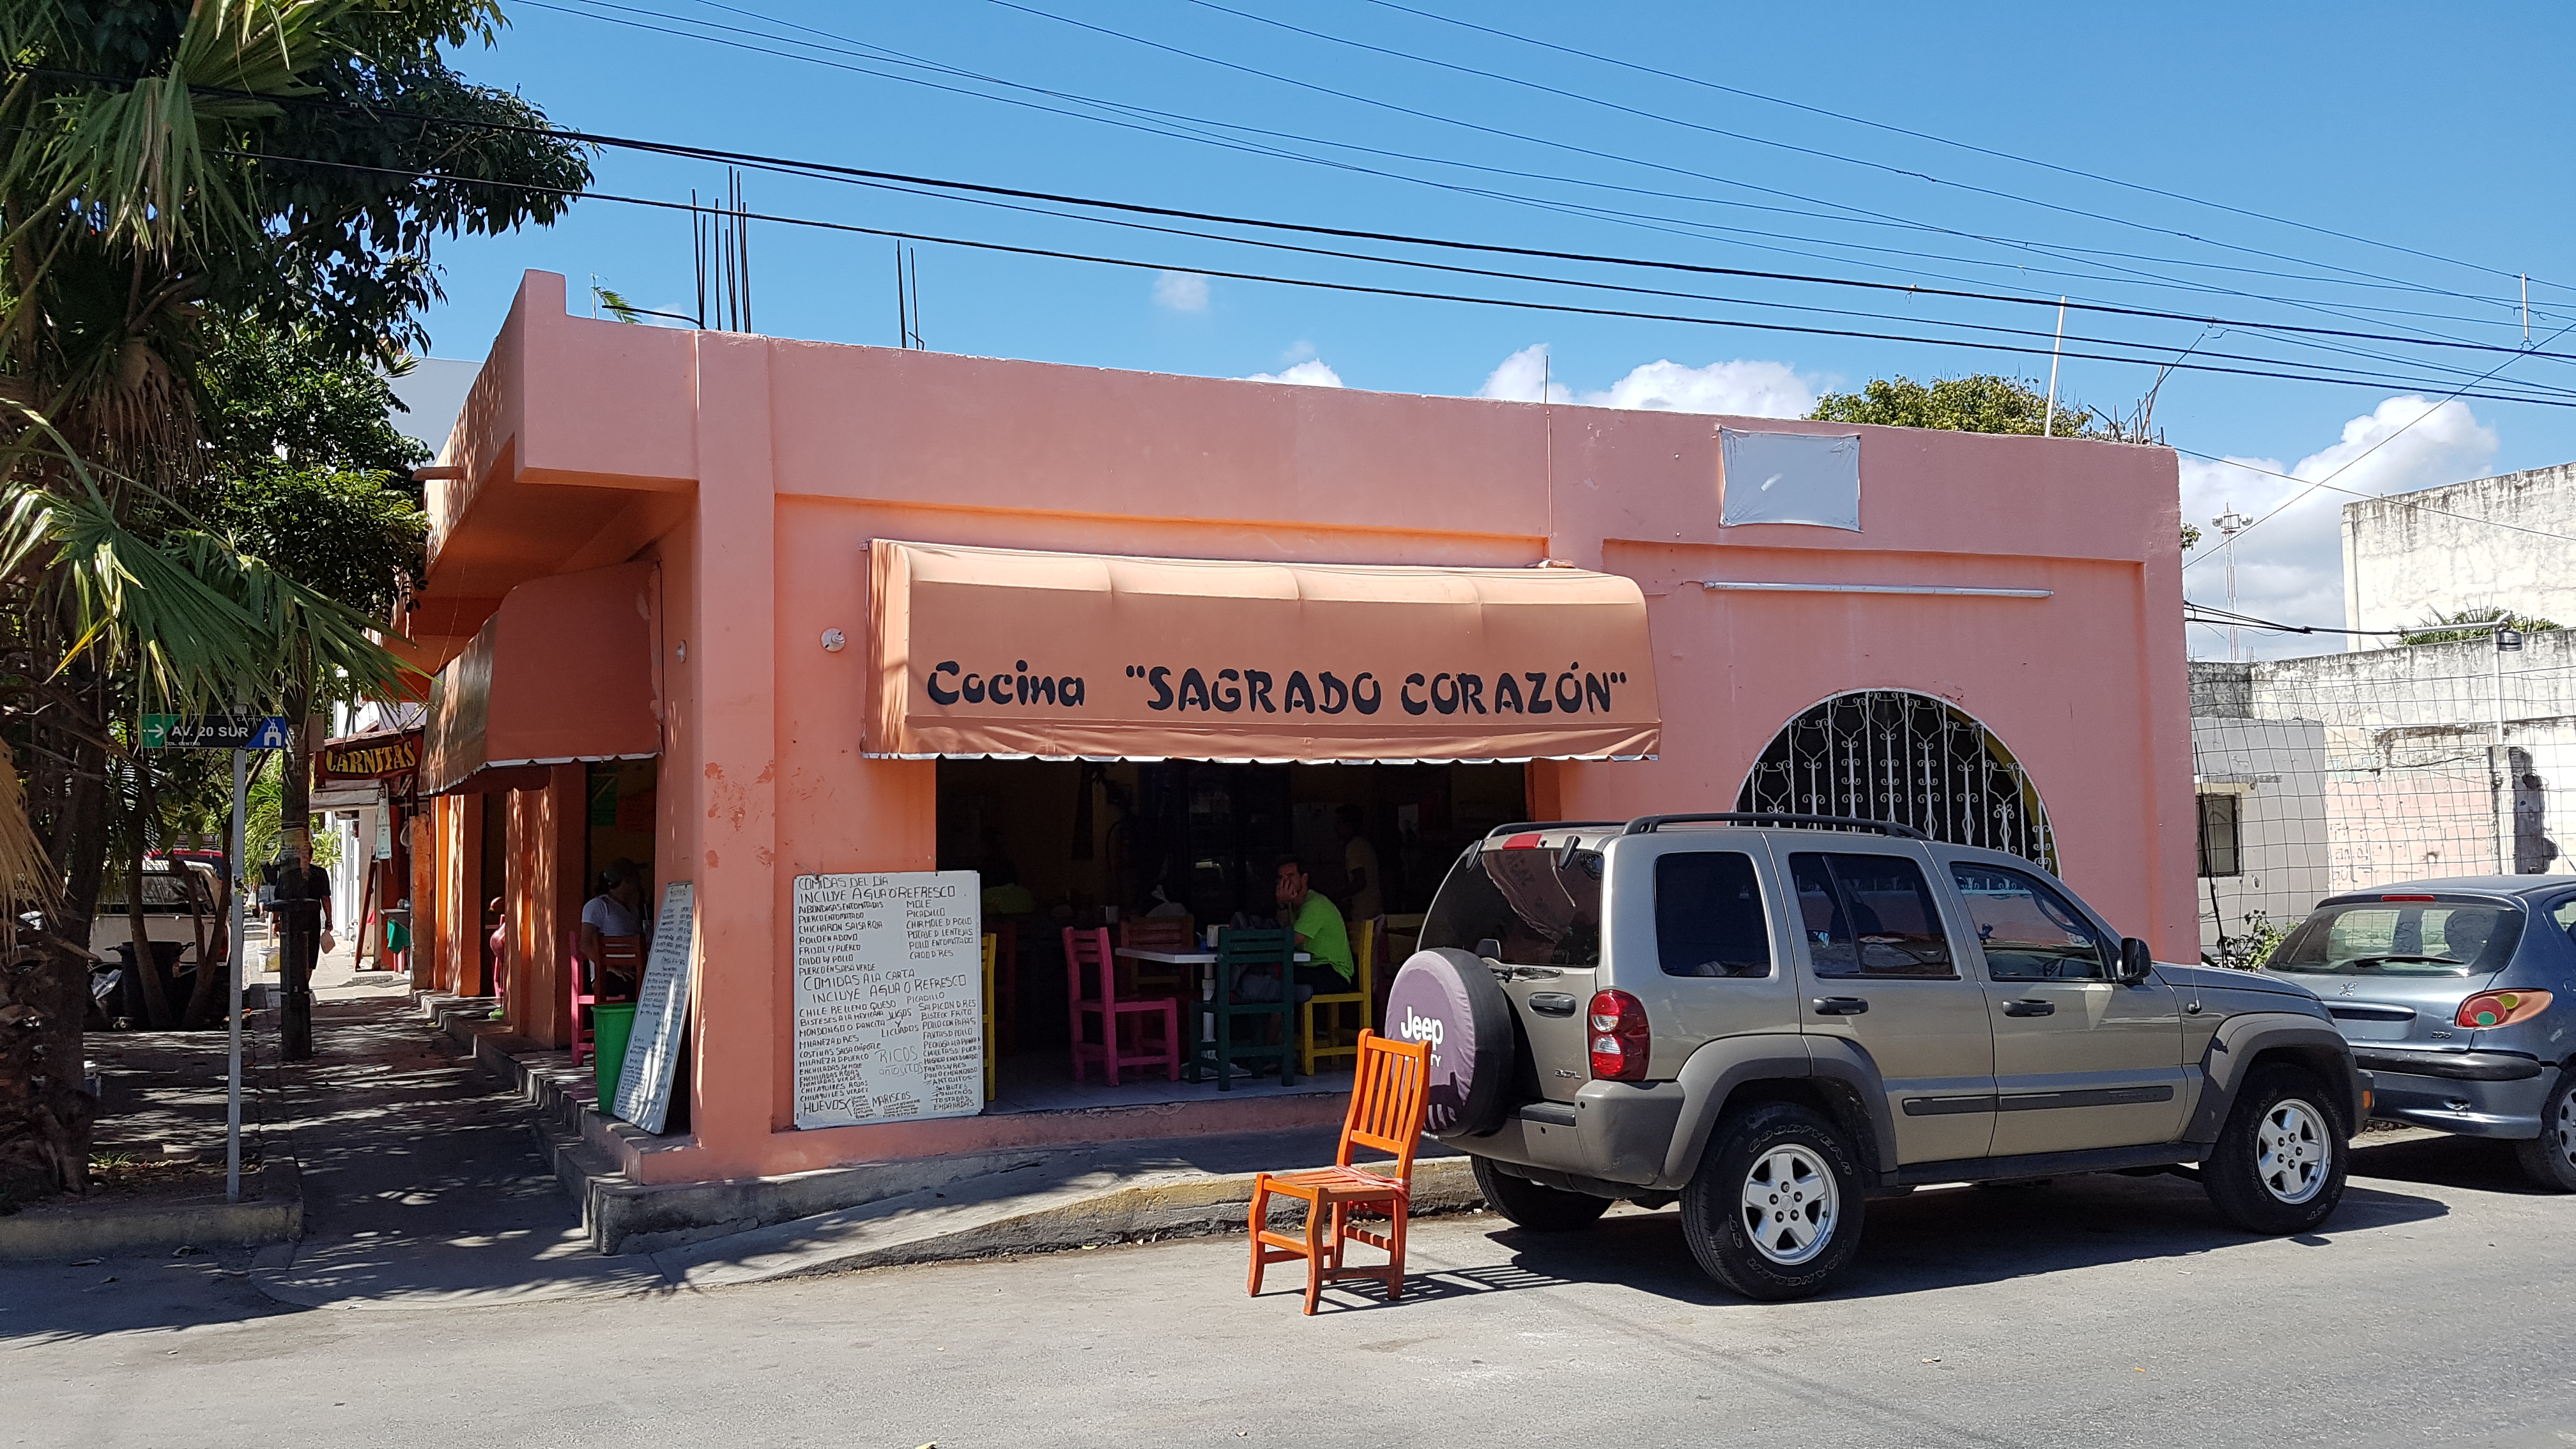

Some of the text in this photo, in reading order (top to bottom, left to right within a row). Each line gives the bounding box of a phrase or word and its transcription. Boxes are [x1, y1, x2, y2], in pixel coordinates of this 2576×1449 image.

[928, 660, 1085, 707] Cocina
[172, 726, 249, 737] AV. 20 SUR
[326, 740, 416, 774] CARNITAS
[799, 877, 847, 891] COMIDAS
[850, 877, 869, 889] DEL
[800, 889, 847, 904] INCLUYE
[852, 887, 886, 901] AGUA
[898, 885, 955, 898] REFRESCO
[906, 900, 931, 908] MOLE
[906, 908, 946, 918] PICADILLO
[942, 928, 973, 937] LENTEJAS
[799, 946, 826, 955] FRIJOL
[937, 949, 954, 958] RES
[856, 963, 876, 972] VERDE
[804, 975, 860, 991] COMIDAS
[863, 973, 870, 985] A
[885, 969, 915, 981] CARTA
[813, 974, 967, 1004] INCLUYE AGUA O REFRESCO
[907, 991, 945, 1004] PICADILLO
[962, 999, 976, 1008] RES
[799, 1007, 827, 1018] CHILE
[870, 1000, 896, 1013] QUESO
[886, 1008, 912, 1020] JUGOS
[950, 1008, 972, 1018] FRITO
[855, 1020, 885, 1030] PANCITA
[882, 1024, 919, 1038] LICUADOS
[1400, 1006, 1444, 1050] Jeep
[875, 1045, 918, 1064] RICOS
[872, 1091, 911, 1107] MARISCOS
[804, 1099, 847, 1116] HUEVOS
[1749, 1124, 1852, 1175] GOODYEAR
